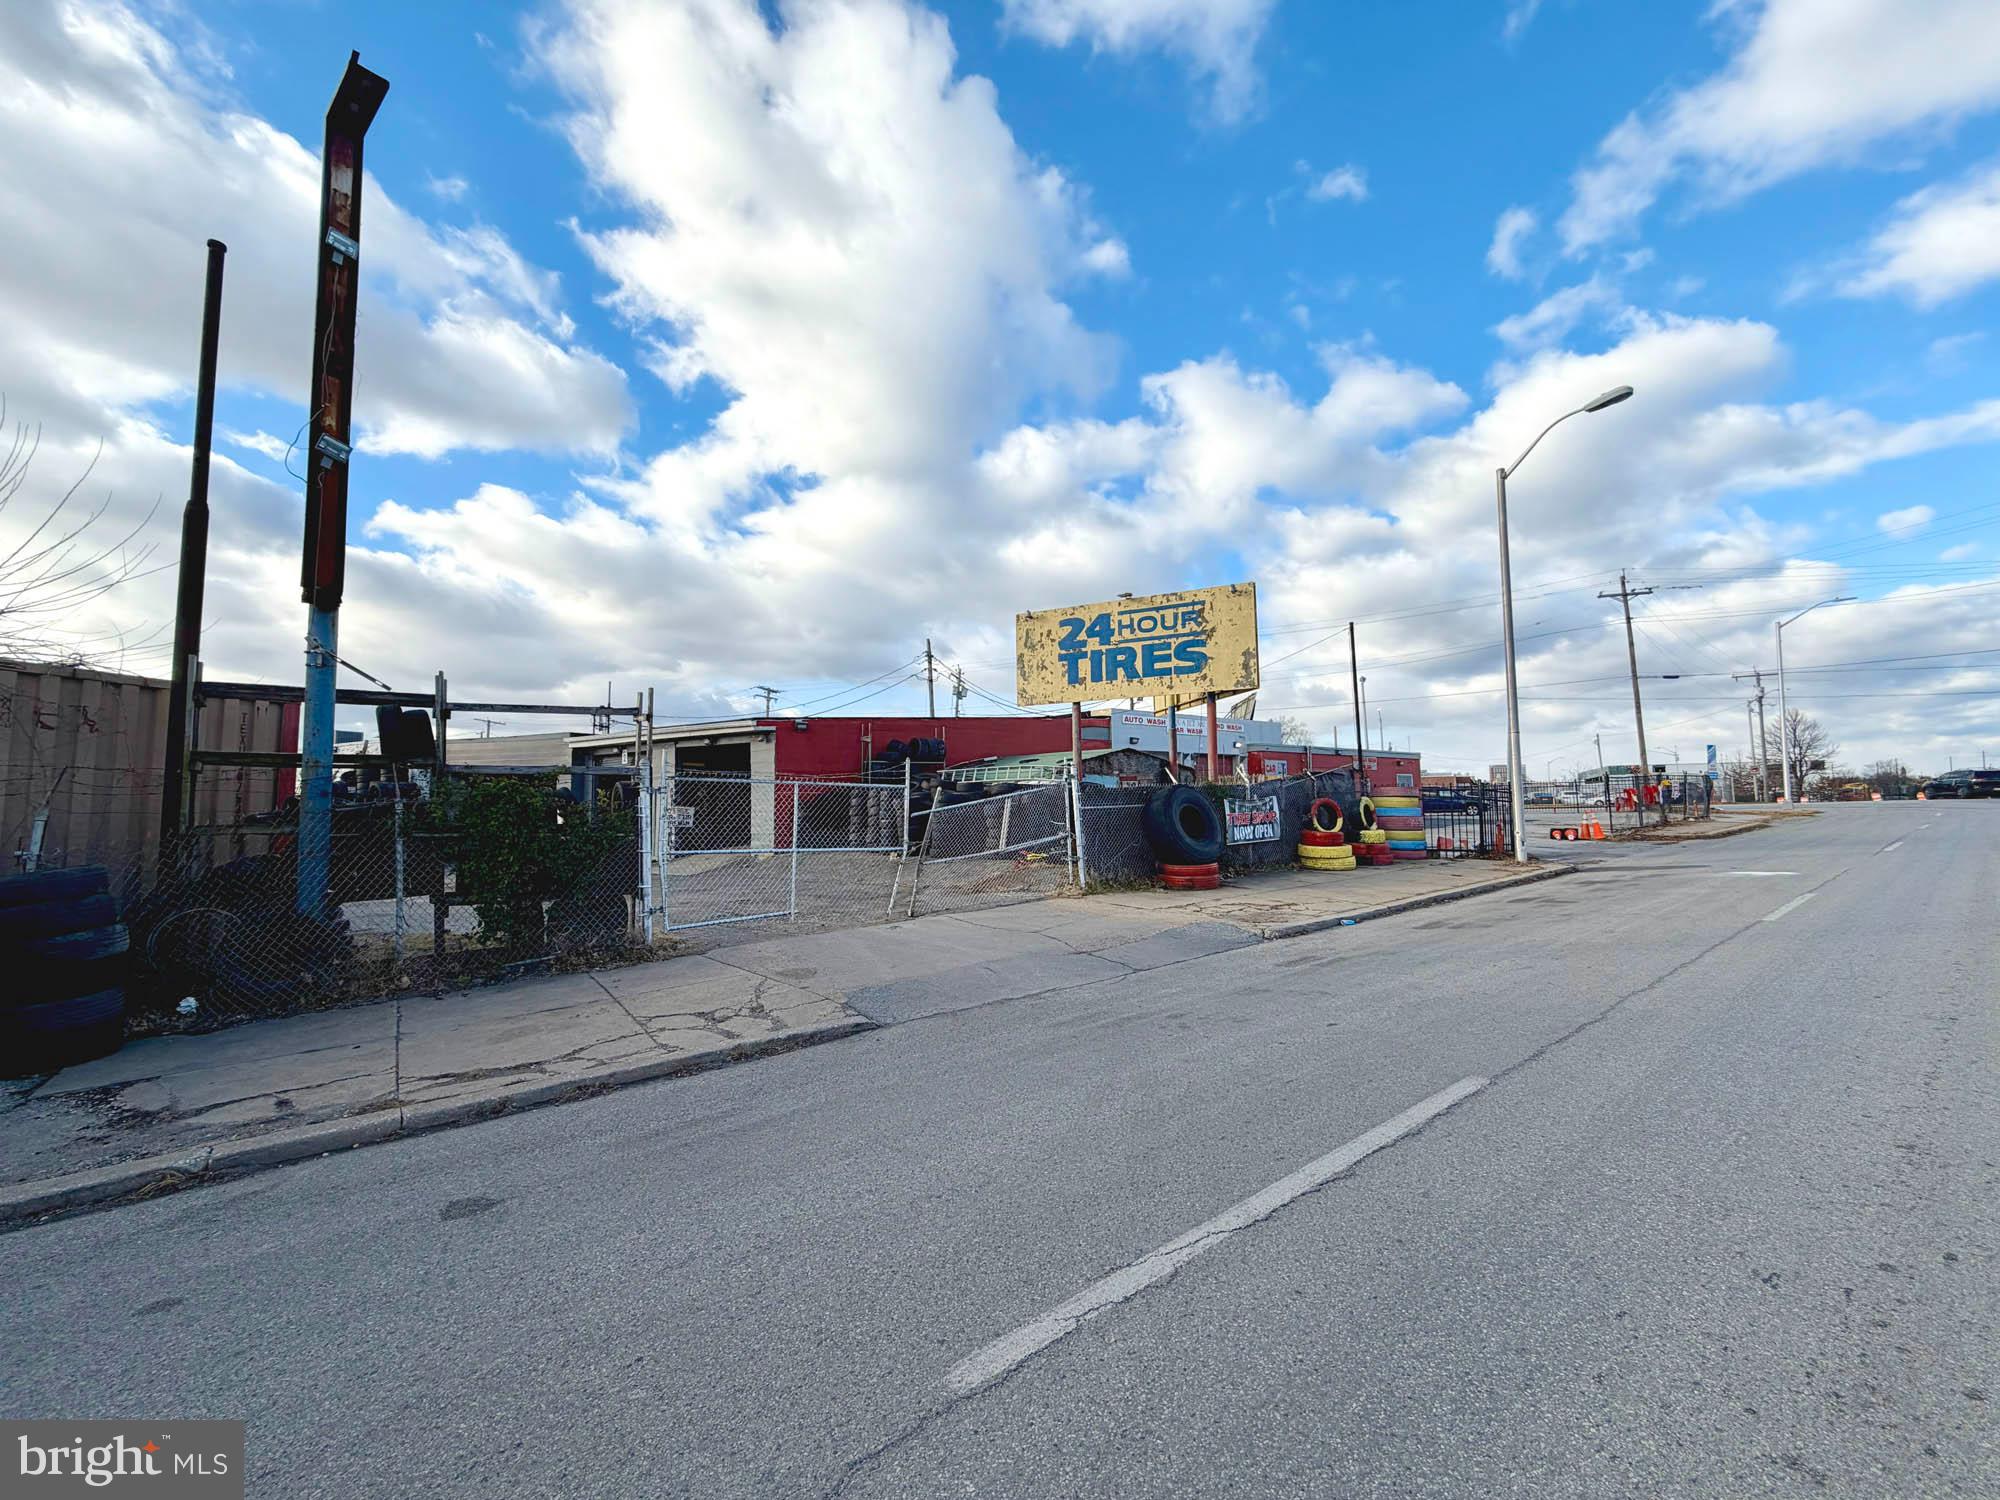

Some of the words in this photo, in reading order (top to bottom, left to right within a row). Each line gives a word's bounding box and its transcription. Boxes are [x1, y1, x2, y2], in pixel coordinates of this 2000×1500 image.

[1058, 613, 1115, 650] 24
[1118, 610, 1208, 636] HOUR
[1058, 639, 1209, 685] TIRES
[1124, 715, 1143, 724] AUTO
[1147, 717, 1166, 726] WASH
[1227, 812, 1251, 825] TIRE
[1252, 810, 1277, 824] SHOP
[1234, 825, 1254, 841] NOW
[1255, 824, 1274, 839] OPEN
